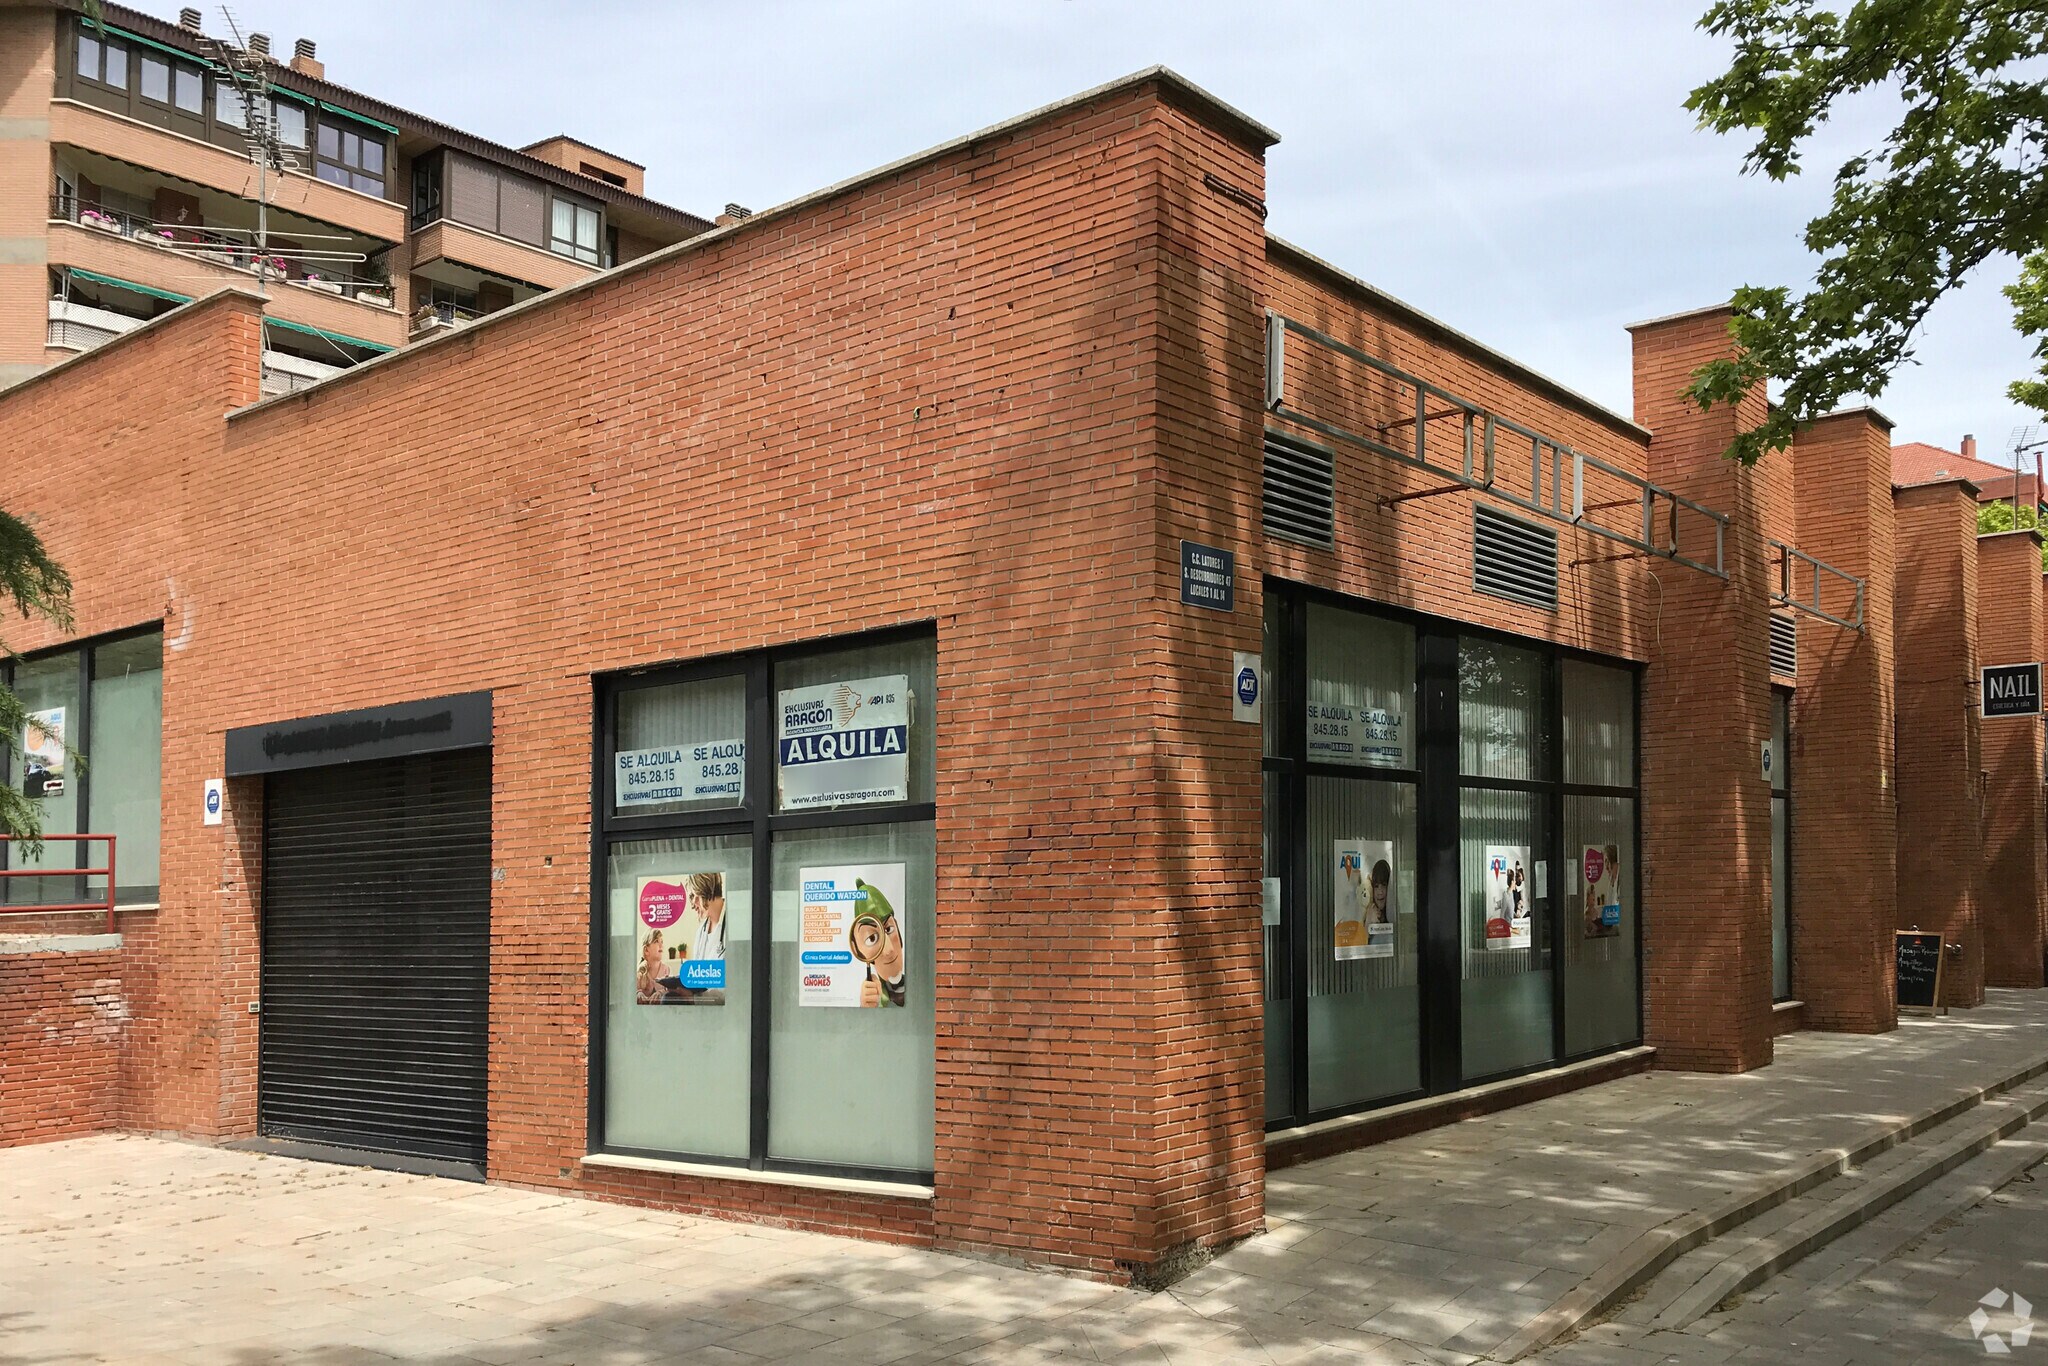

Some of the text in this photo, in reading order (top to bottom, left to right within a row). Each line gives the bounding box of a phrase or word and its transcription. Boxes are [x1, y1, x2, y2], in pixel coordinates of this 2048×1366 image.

[1184, 566, 1189, 579] S.
[1225, 575, 1231, 587] 47
[1190, 583, 1209, 598] LOCALES
[1213, 588, 1219, 600] AL
[1241, 678, 1255, 692] ADT
[1990, 674, 2036, 699] NAIL
[784, 699, 824, 714] EXCLUSIVAS
[871, 696, 884, 705] API
[785, 708, 833, 728] ARAGON
[1308, 705, 1353, 721] SE ALQUILA
[1360, 711, 1402, 727] SE ALQUILA
[1313, 723, 1348, 737] 845.28.15
[1365, 728, 1398, 741] 845.28.15
[787, 728, 901, 763] ALQUILA
[620, 750, 682, 769] SE ALQUILA
[694, 747, 708, 761] SE
[628, 768, 675, 785] 845.28.15
[623, 787, 682, 801] EXCLUSIVAS ARAGON
[695, 784, 727, 794] EXCLUSIVAS
[791, 789, 895, 804] www.exclusivasaragon.com
[805, 882, 833, 890] DENTAL,
[805, 891, 867, 901] QUERIDO WATSON
[648, 904, 657, 922] 3
[687, 964, 722, 978] Adeslas
[803, 976, 831, 987] GNOMES
